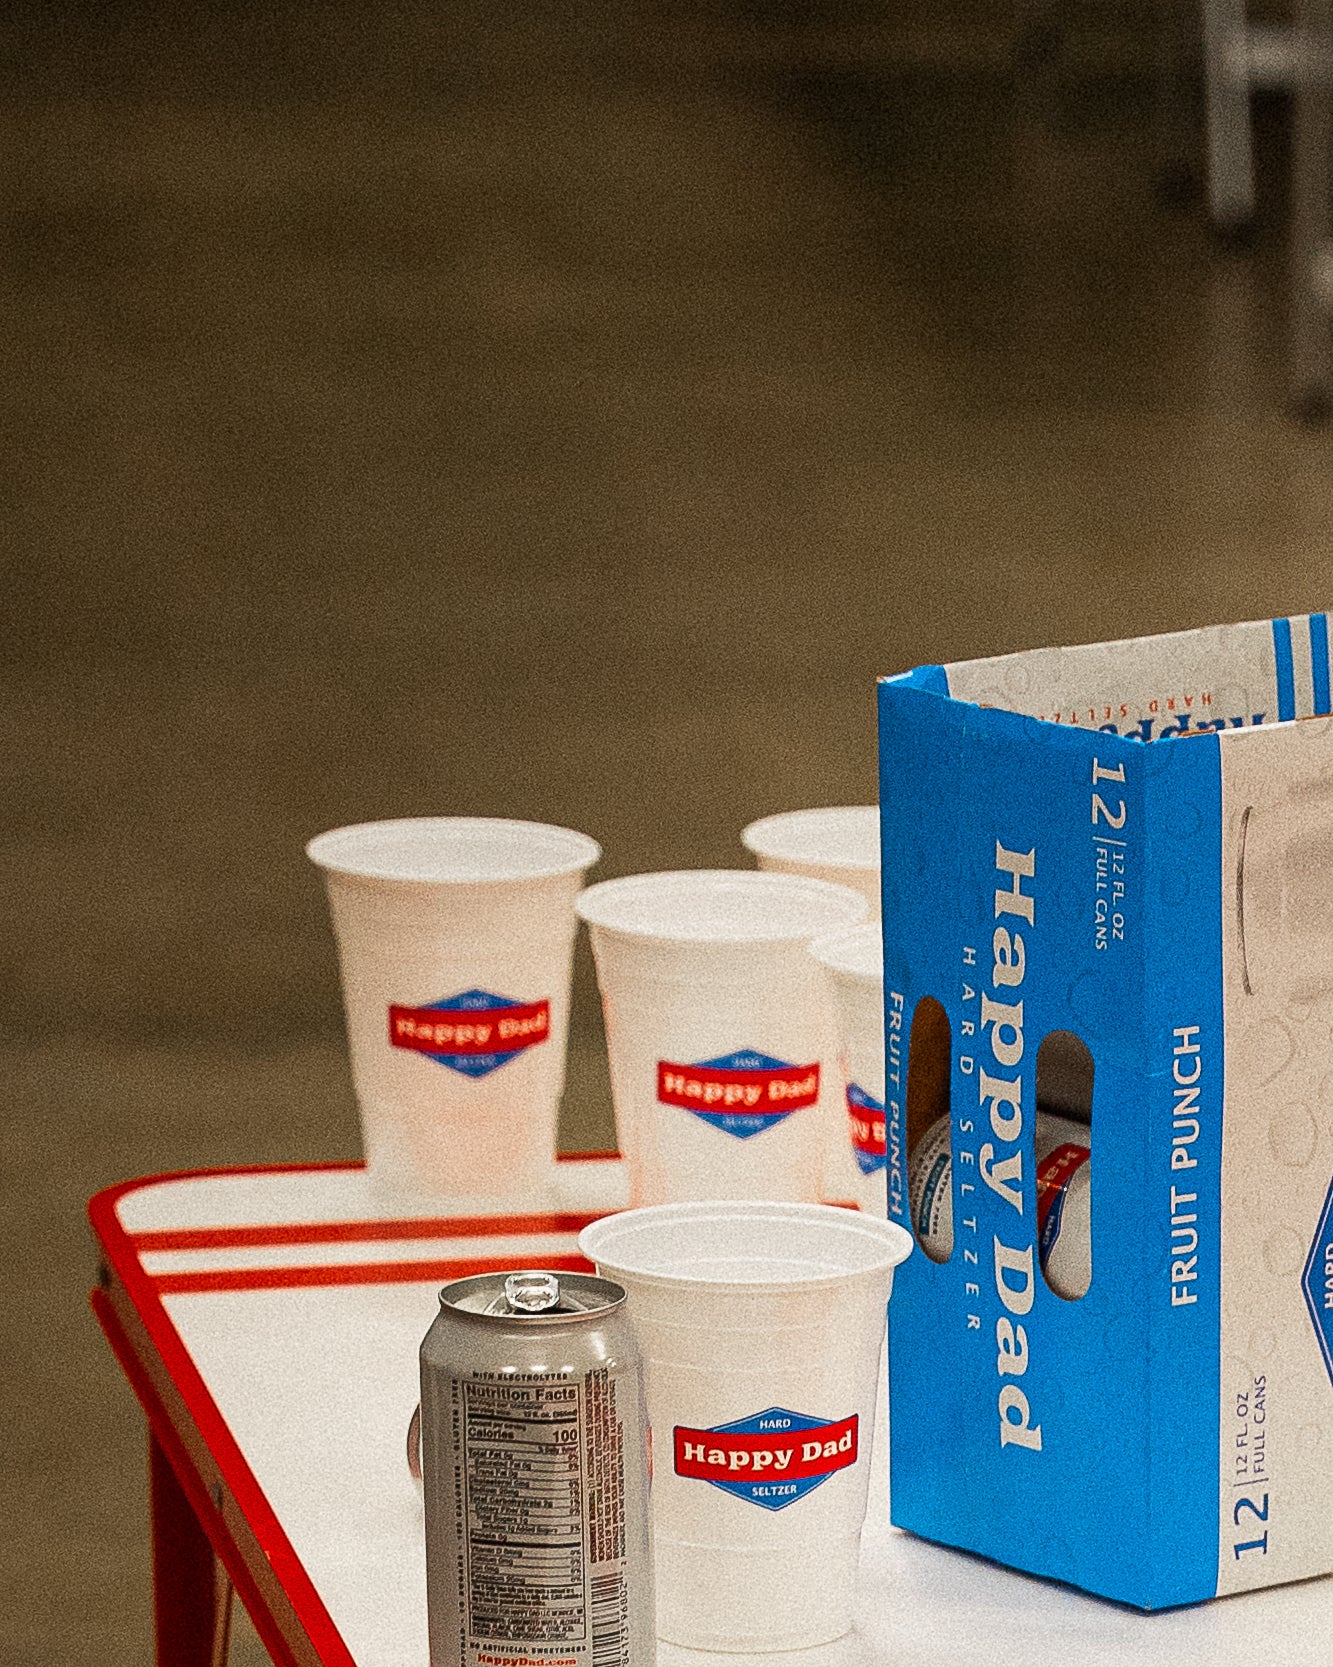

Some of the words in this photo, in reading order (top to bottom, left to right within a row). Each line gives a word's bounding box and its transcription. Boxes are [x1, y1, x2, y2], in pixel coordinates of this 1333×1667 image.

[1038, 704, 1128, 724] SELTZ
[1092, 757, 1126, 829] 12
[1096, 847, 1108, 892] FULL
[1112, 852, 1125, 874] 12
[1095, 899, 1108, 950] CANS
[1112, 913, 1125, 941] OZ
[395, 1017, 493, 1046] Happy
[960, 946, 977, 1077] HARD
[978, 838, 1038, 1217] Happy
[889, 991, 904, 1090] FRUIT
[663, 1071, 763, 1106] Happy
[768, 1071, 816, 1101] Dad
[1171, 1025, 1201, 1170] PUNCH
[889, 1101, 903, 1216] PUNCH
[959, 1118, 981, 1332] SELTZER
[1170, 1185, 1199, 1307] FRUIT
[993, 1234, 1043, 1454] Dad
[466, 1384, 530, 1400] Nutrition
[535, 1387, 576, 1401] Facts
[1236, 1391, 1249, 1418] OZ
[1254, 1375, 1267, 1424] CANS
[468, 1427, 514, 1439] Calories
[552, 1428, 578, 1443] 100
[759, 1418, 791, 1429] HARD
[683, 1441, 794, 1471] Happy
[801, 1429, 852, 1462] Dad
[1236, 1455, 1248, 1475] 12
[1254, 1430, 1265, 1474] FULL
[751, 1484, 797, 1497] SELTZER
[1233, 1493, 1269, 1561] 12
[478, 1653, 577, 1667] HappyDad.com
